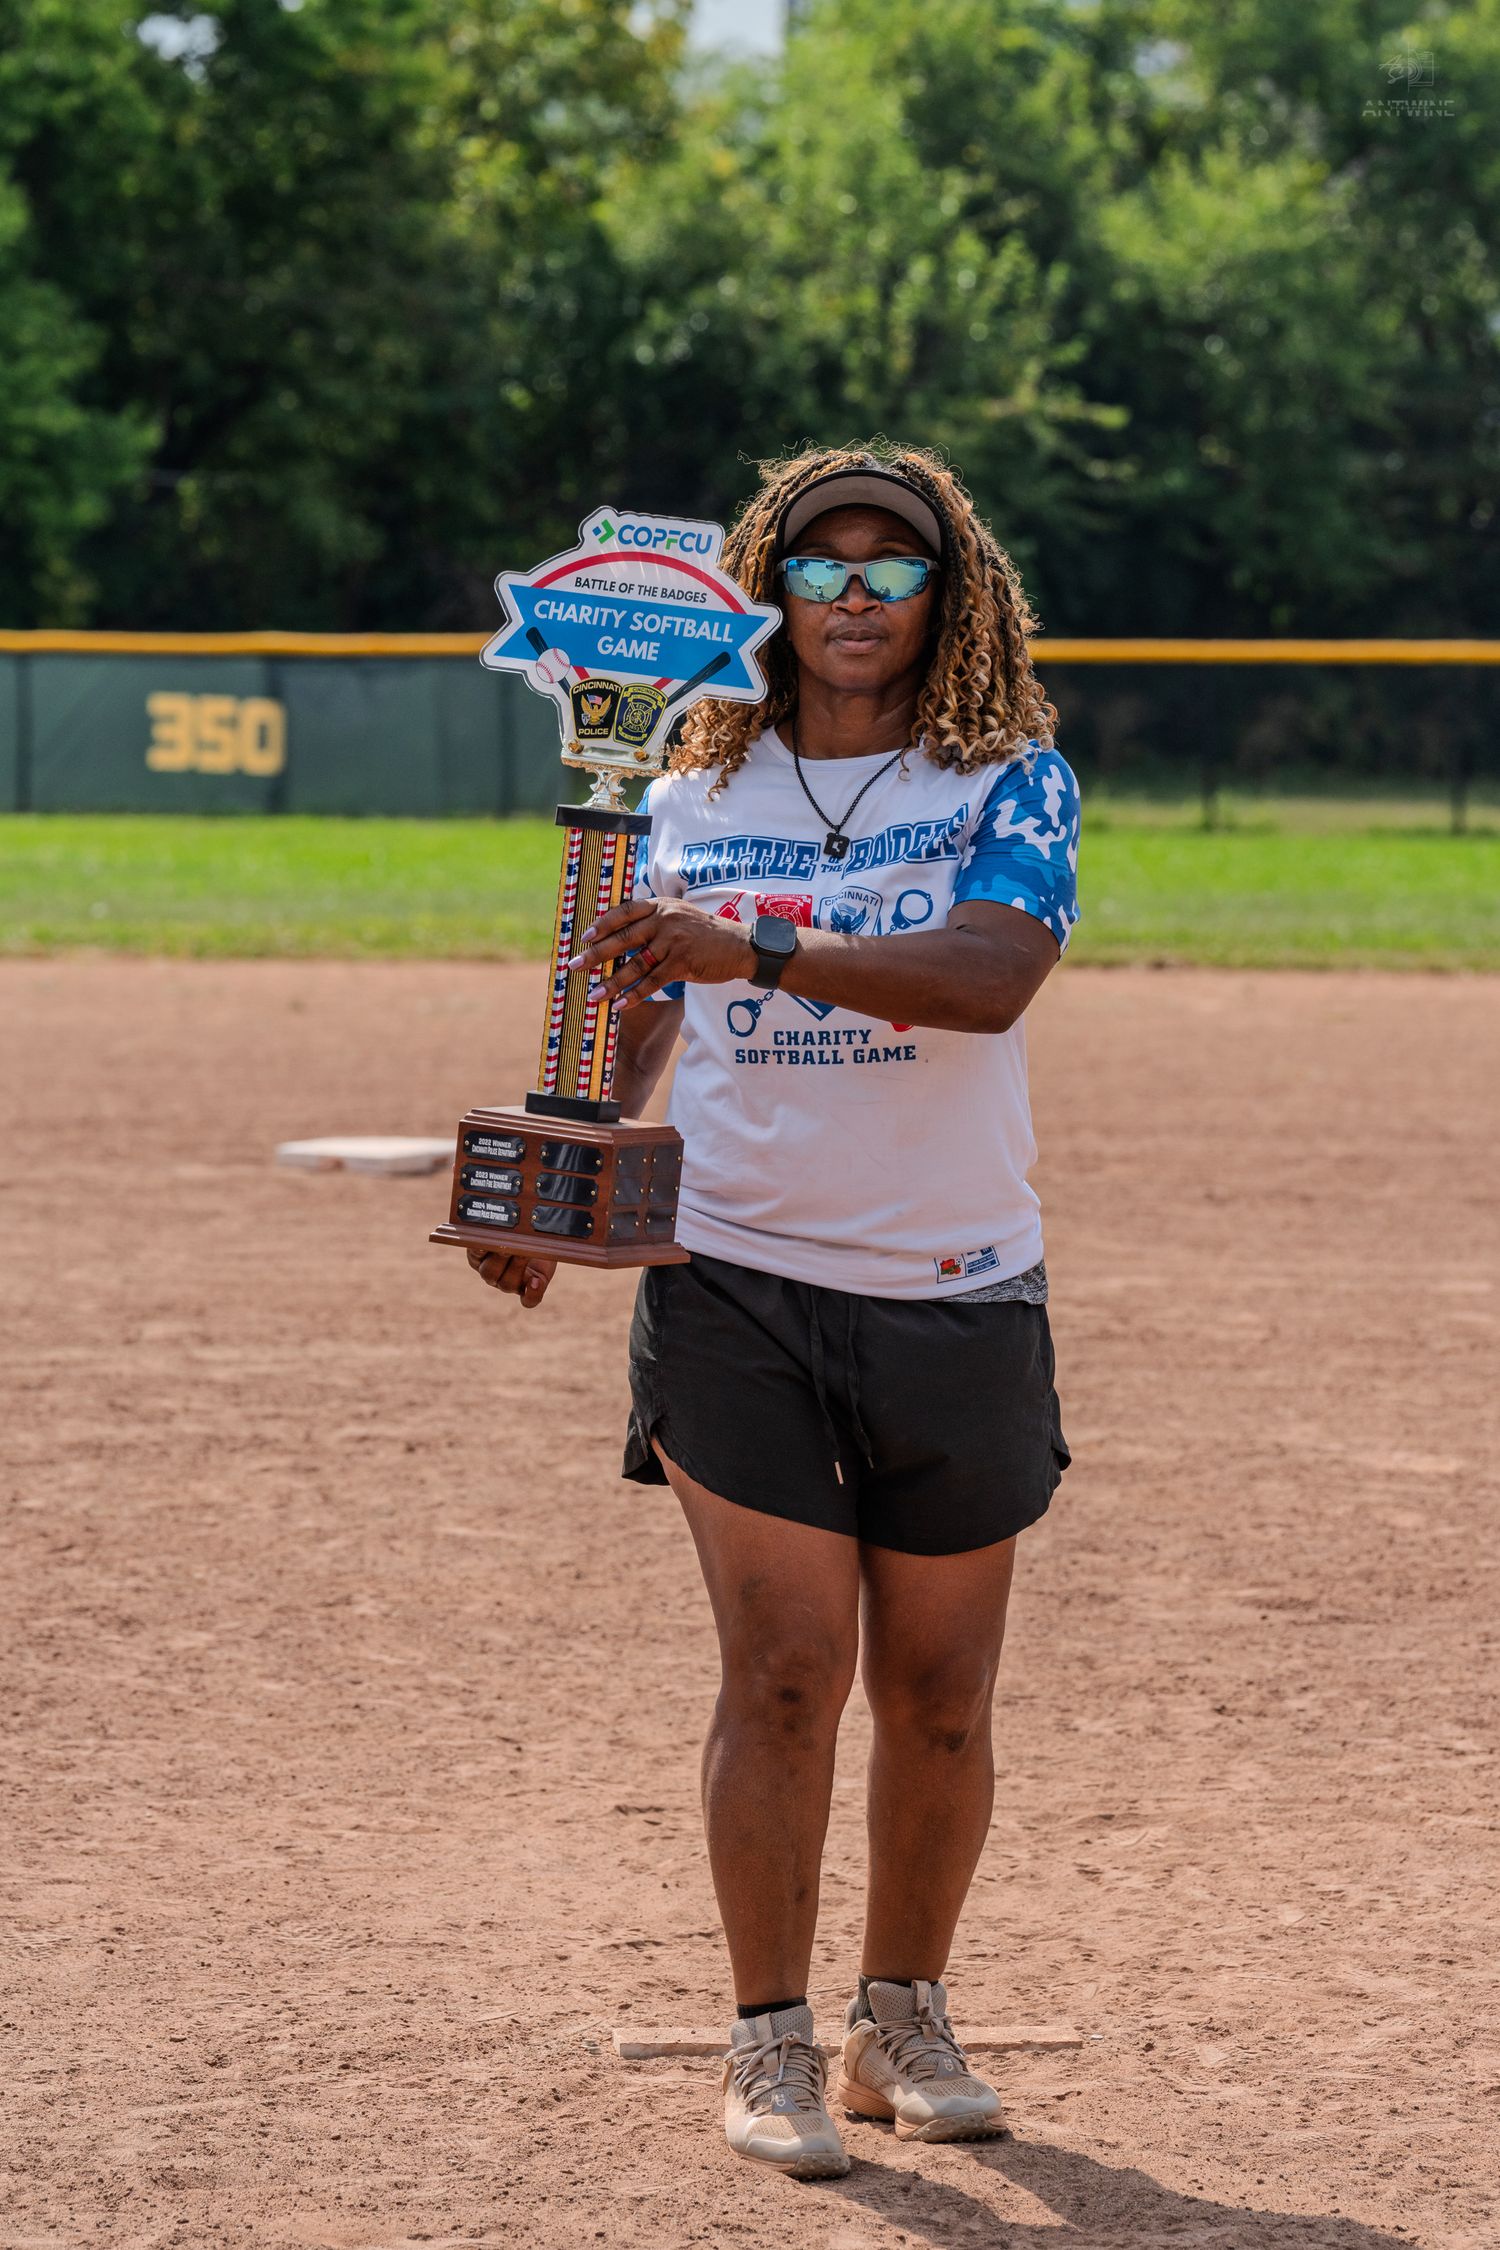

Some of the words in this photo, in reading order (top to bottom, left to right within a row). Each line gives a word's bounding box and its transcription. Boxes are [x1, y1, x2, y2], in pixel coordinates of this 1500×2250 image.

[617, 523, 713, 555] COPFCU
[574, 577, 616, 593] BATTLE
[618, 583, 635, 595] OF
[637, 584, 659, 598] THE
[660, 586, 707, 603] BADGES
[533, 599, 627, 630] CHARITY
[629, 611, 733, 643] SOFTBALL
[597, 635, 661, 661] GAME
[573, 681, 621, 694] CINCINNATI
[146, 690, 287, 777] 350
[578, 728, 609, 736] POLICE
[678, 835, 821, 891] BATTLE
[824, 891, 879, 907] CICINNATI
[773, 1029, 872, 1046] CHARITY
[735, 1049, 844, 1065] SOFTBALL
[853, 1045, 917, 1064] GAME
[479, 1138, 492, 1146] 2022
[492, 1140, 511, 1149] WINNER
[475, 1171, 488, 1179] 2023
[489, 1173, 508, 1181] WINNER
[472, 1201, 485, 1209] 2024
[486, 1203, 505, 1212] WINNER
